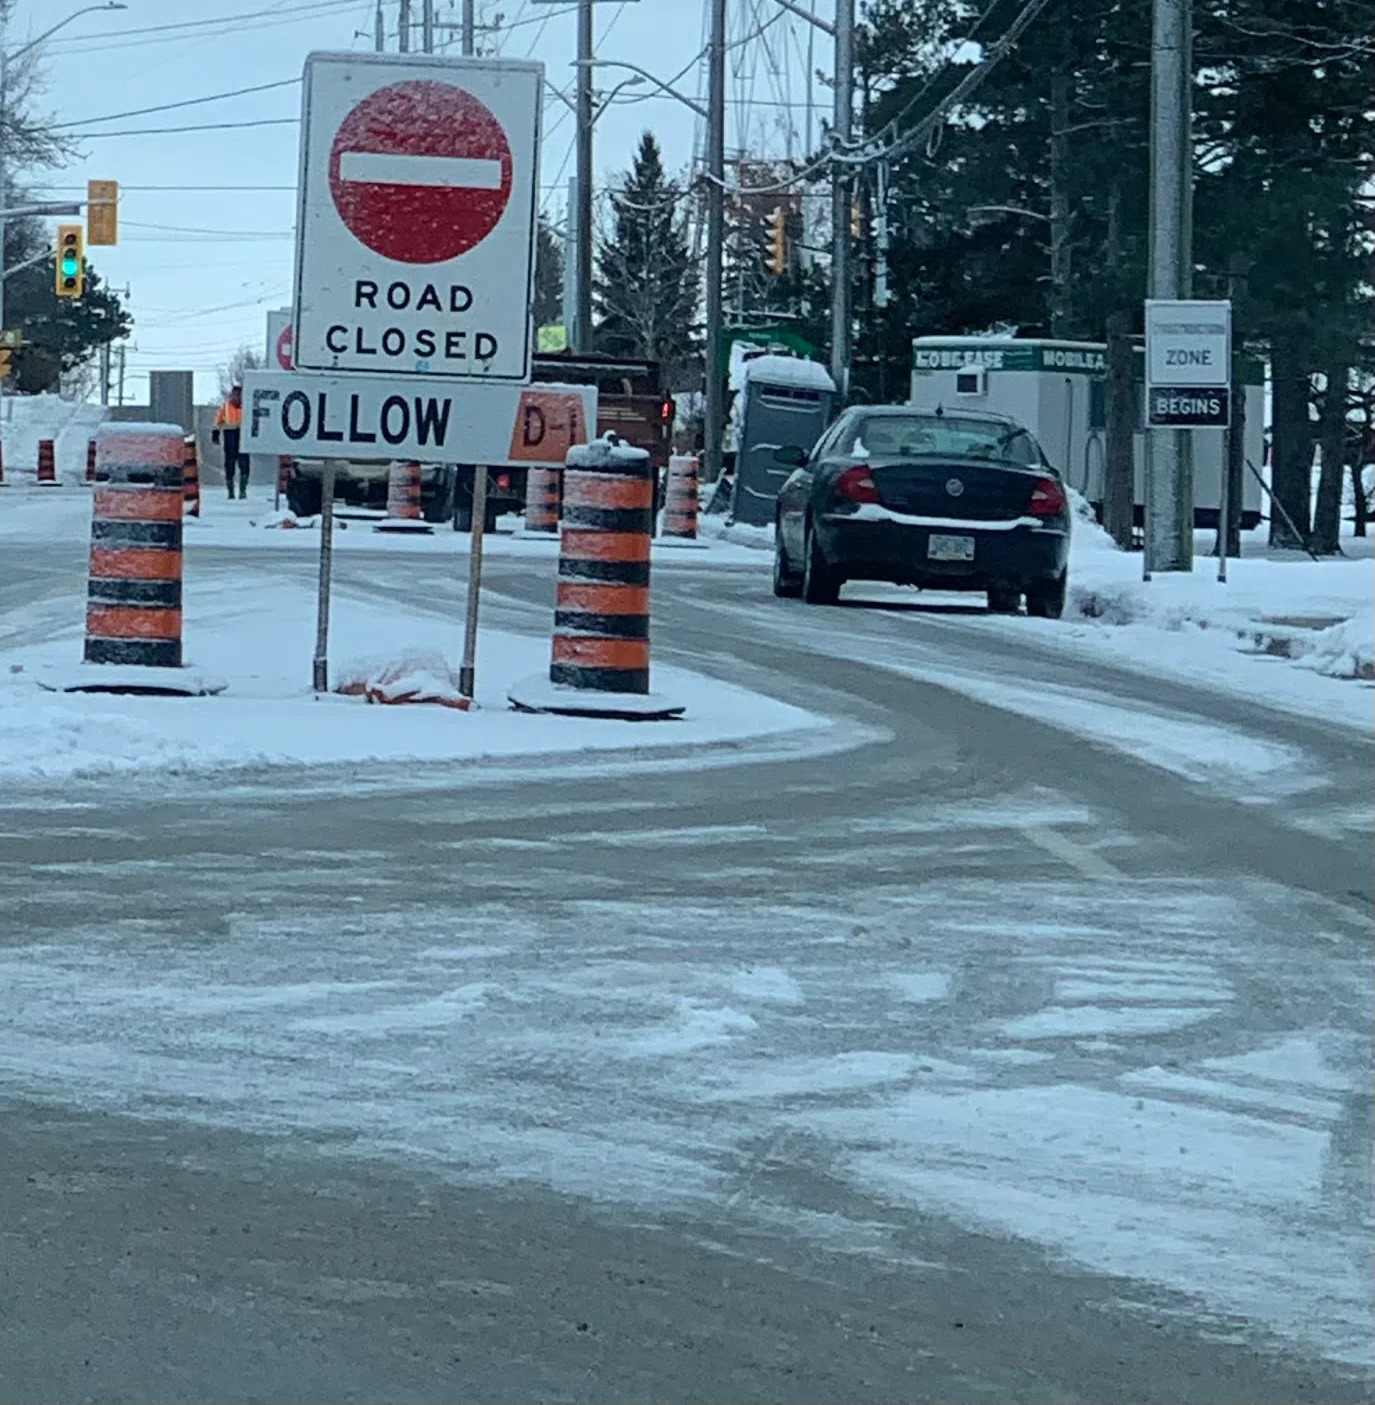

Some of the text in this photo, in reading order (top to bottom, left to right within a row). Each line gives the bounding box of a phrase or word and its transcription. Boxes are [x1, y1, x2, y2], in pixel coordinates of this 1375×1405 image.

[355, 280, 473, 312] ROAD
[326, 325, 498, 360] CLOSED
[1165, 349, 1213, 366] ZONE
[251, 389, 452, 446] FOLLOW
[1156, 397, 1221, 415] BEGINS
